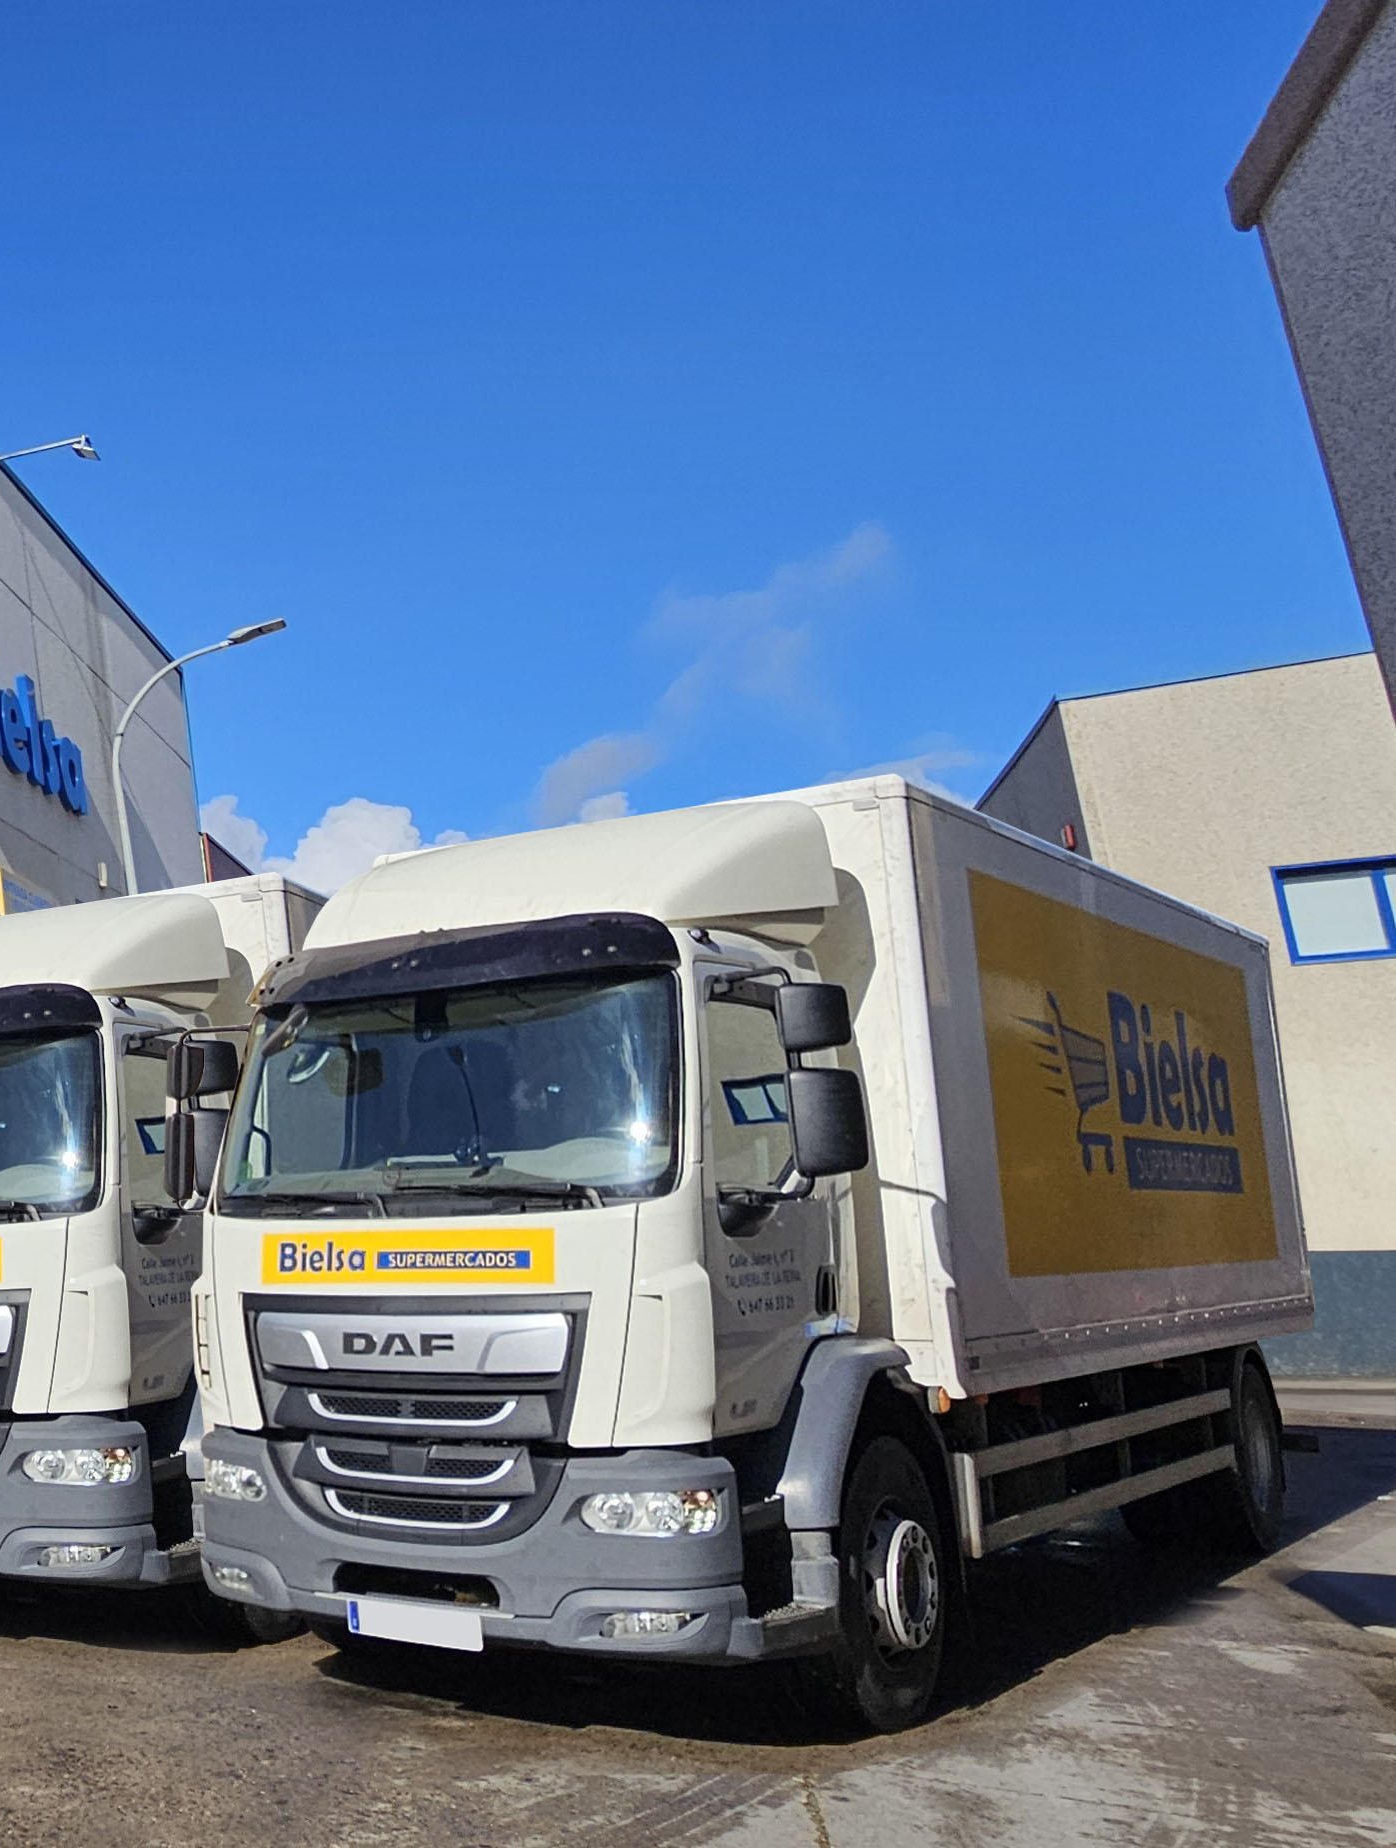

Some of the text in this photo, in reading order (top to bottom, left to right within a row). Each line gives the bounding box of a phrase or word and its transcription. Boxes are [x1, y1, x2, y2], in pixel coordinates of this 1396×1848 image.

[1108, 991, 1235, 1137] Bielsa
[1136, 1147, 1234, 1185] SUPERMERCADOS
[279, 1241, 517, 1273] Bielsa SUPERMERCADOS
[342, 1332, 454, 1357] DAF
